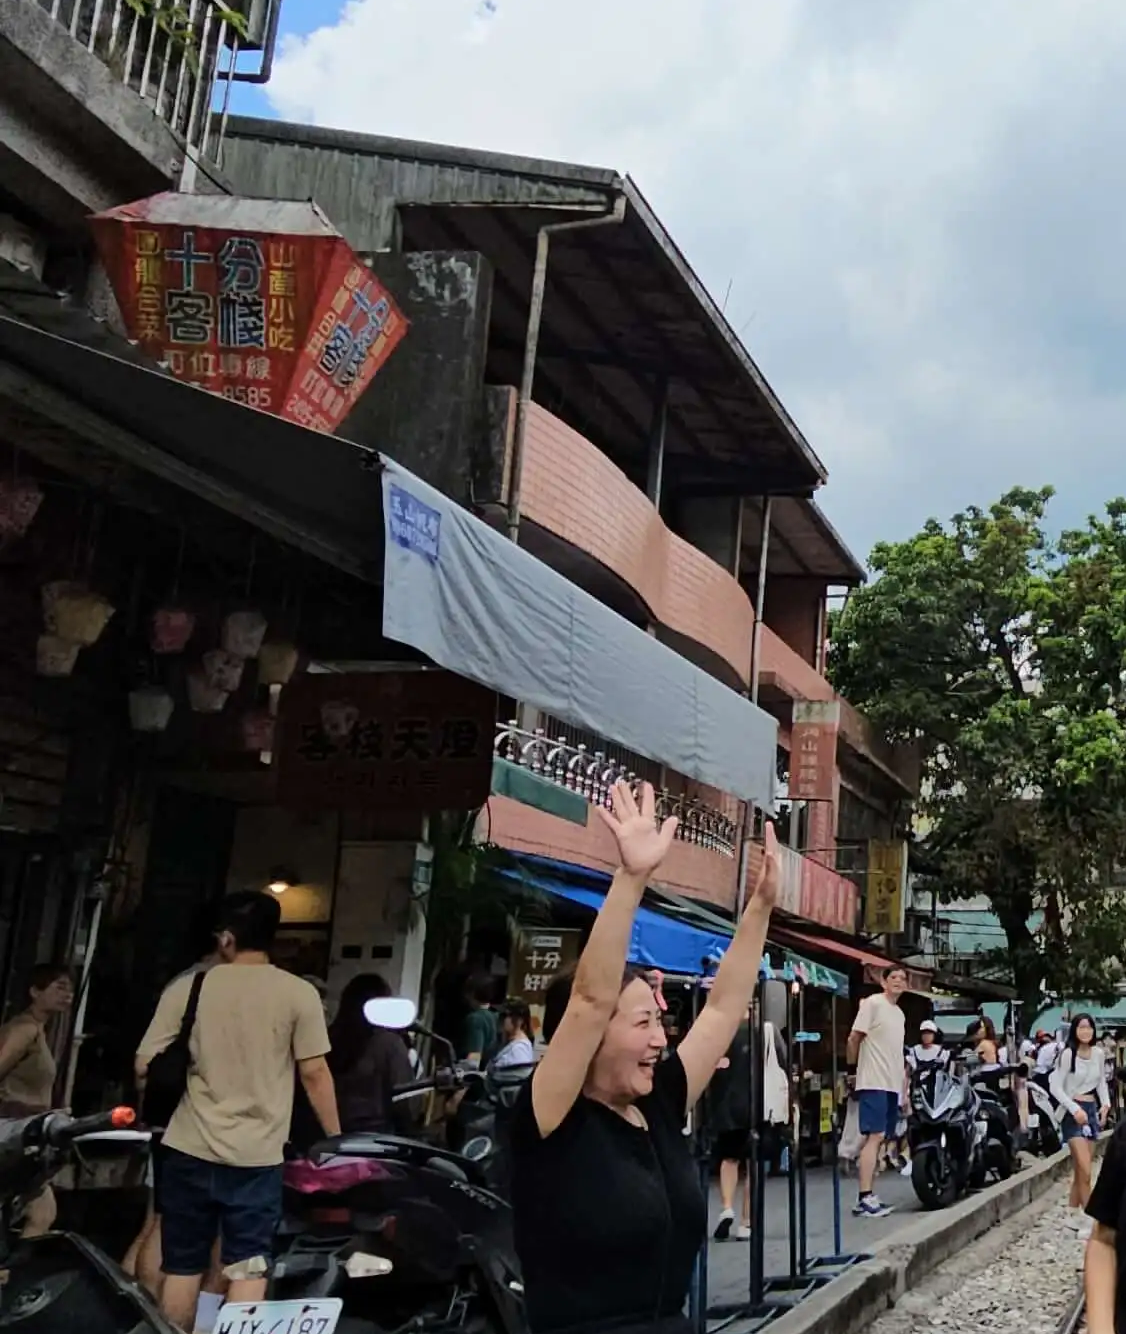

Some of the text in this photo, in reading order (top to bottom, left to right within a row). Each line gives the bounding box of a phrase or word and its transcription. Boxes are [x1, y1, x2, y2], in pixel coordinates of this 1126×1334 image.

[164, 230, 266, 293] 十分
[268, 241, 296, 352] 山產小吃
[525, 950, 562, 969] 十分
